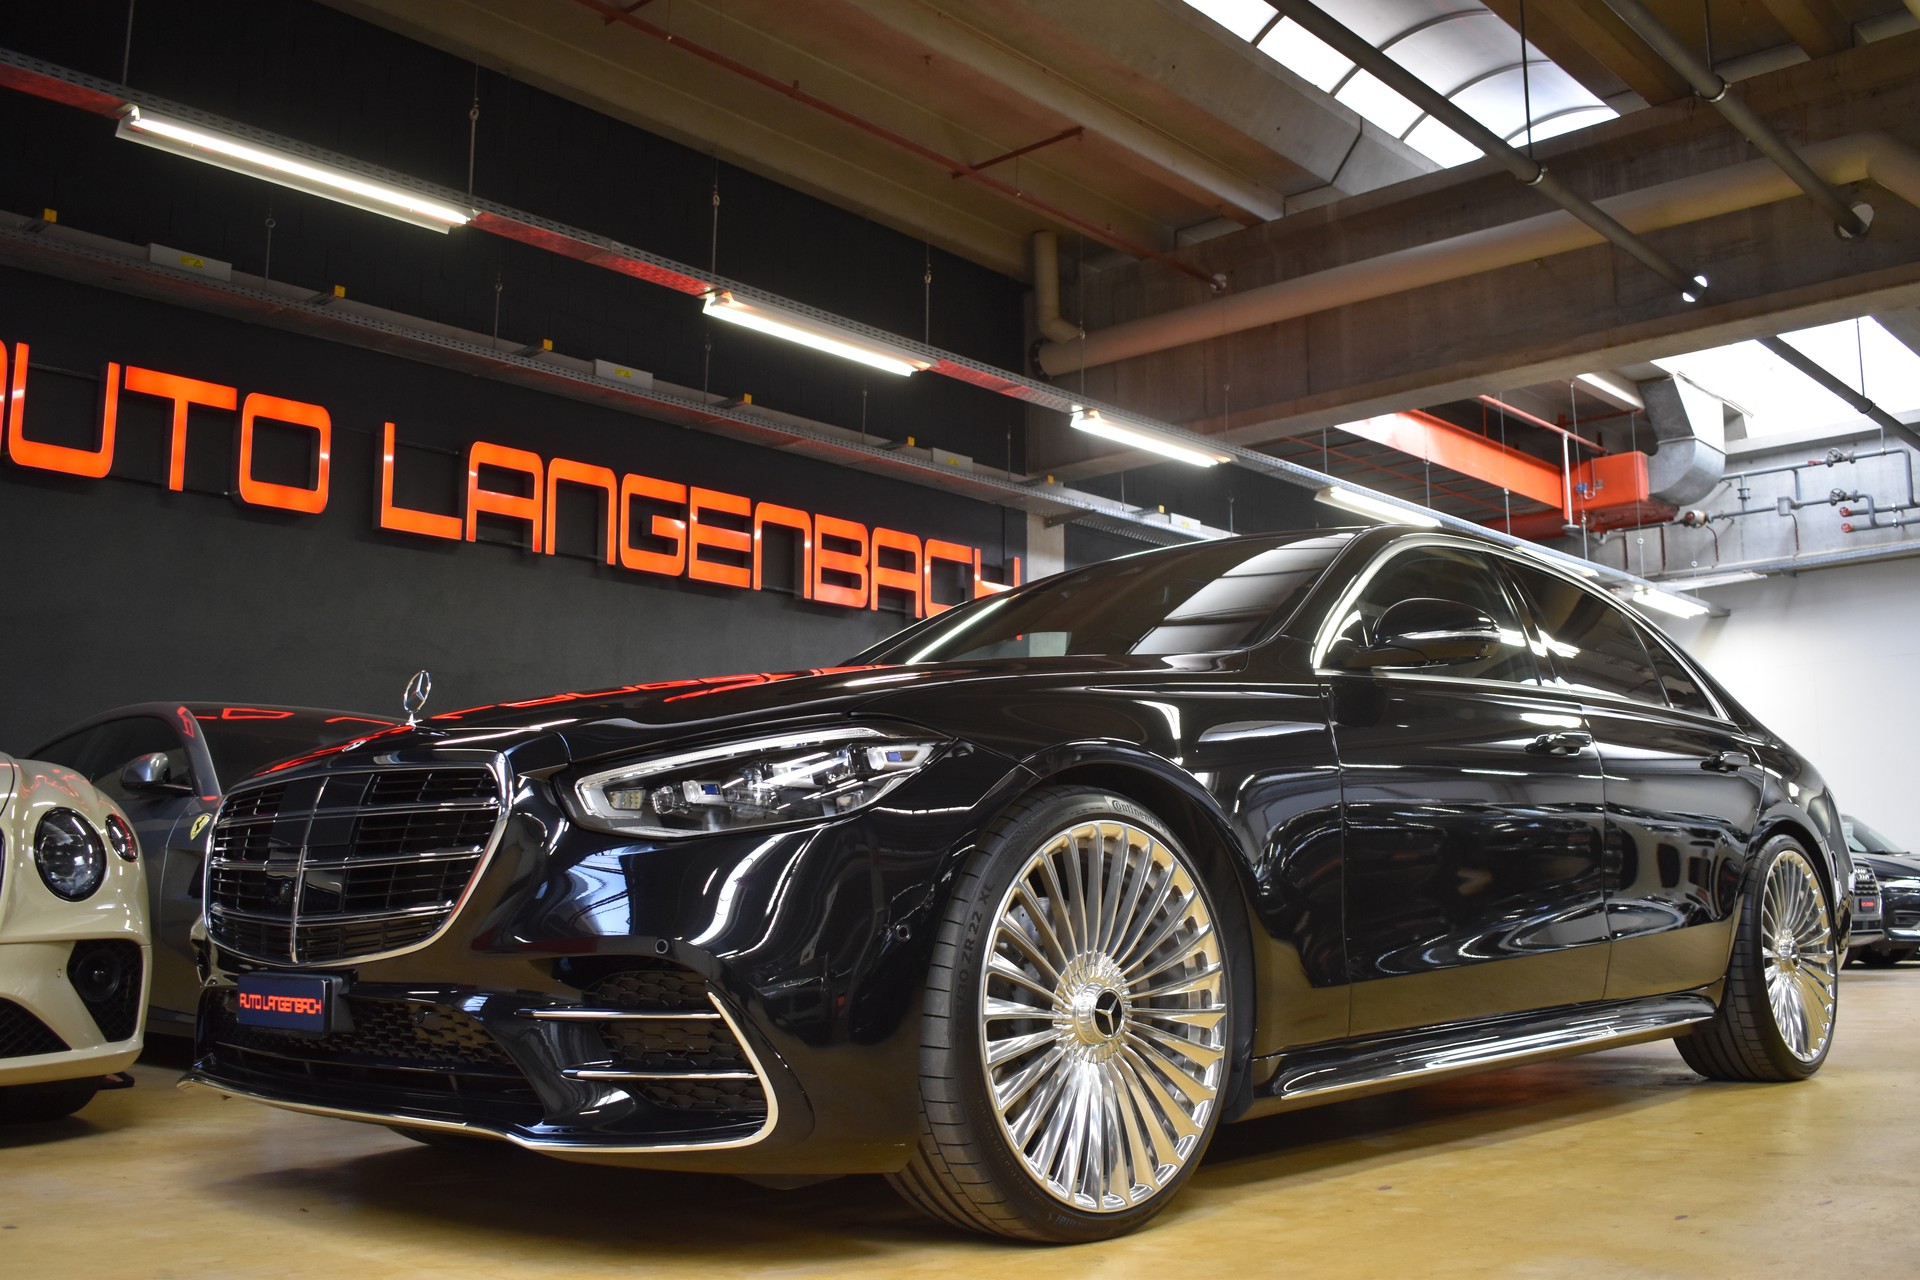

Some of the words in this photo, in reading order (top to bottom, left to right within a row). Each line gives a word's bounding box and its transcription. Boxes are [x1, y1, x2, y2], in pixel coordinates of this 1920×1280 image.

[0, 339, 331, 514] UTO
[1112, 800, 1161, 830] Continental
[969, 911, 982, 935] 22
[979, 883, 995, 905] XL
[240, 993, 262, 1010] AUTO
